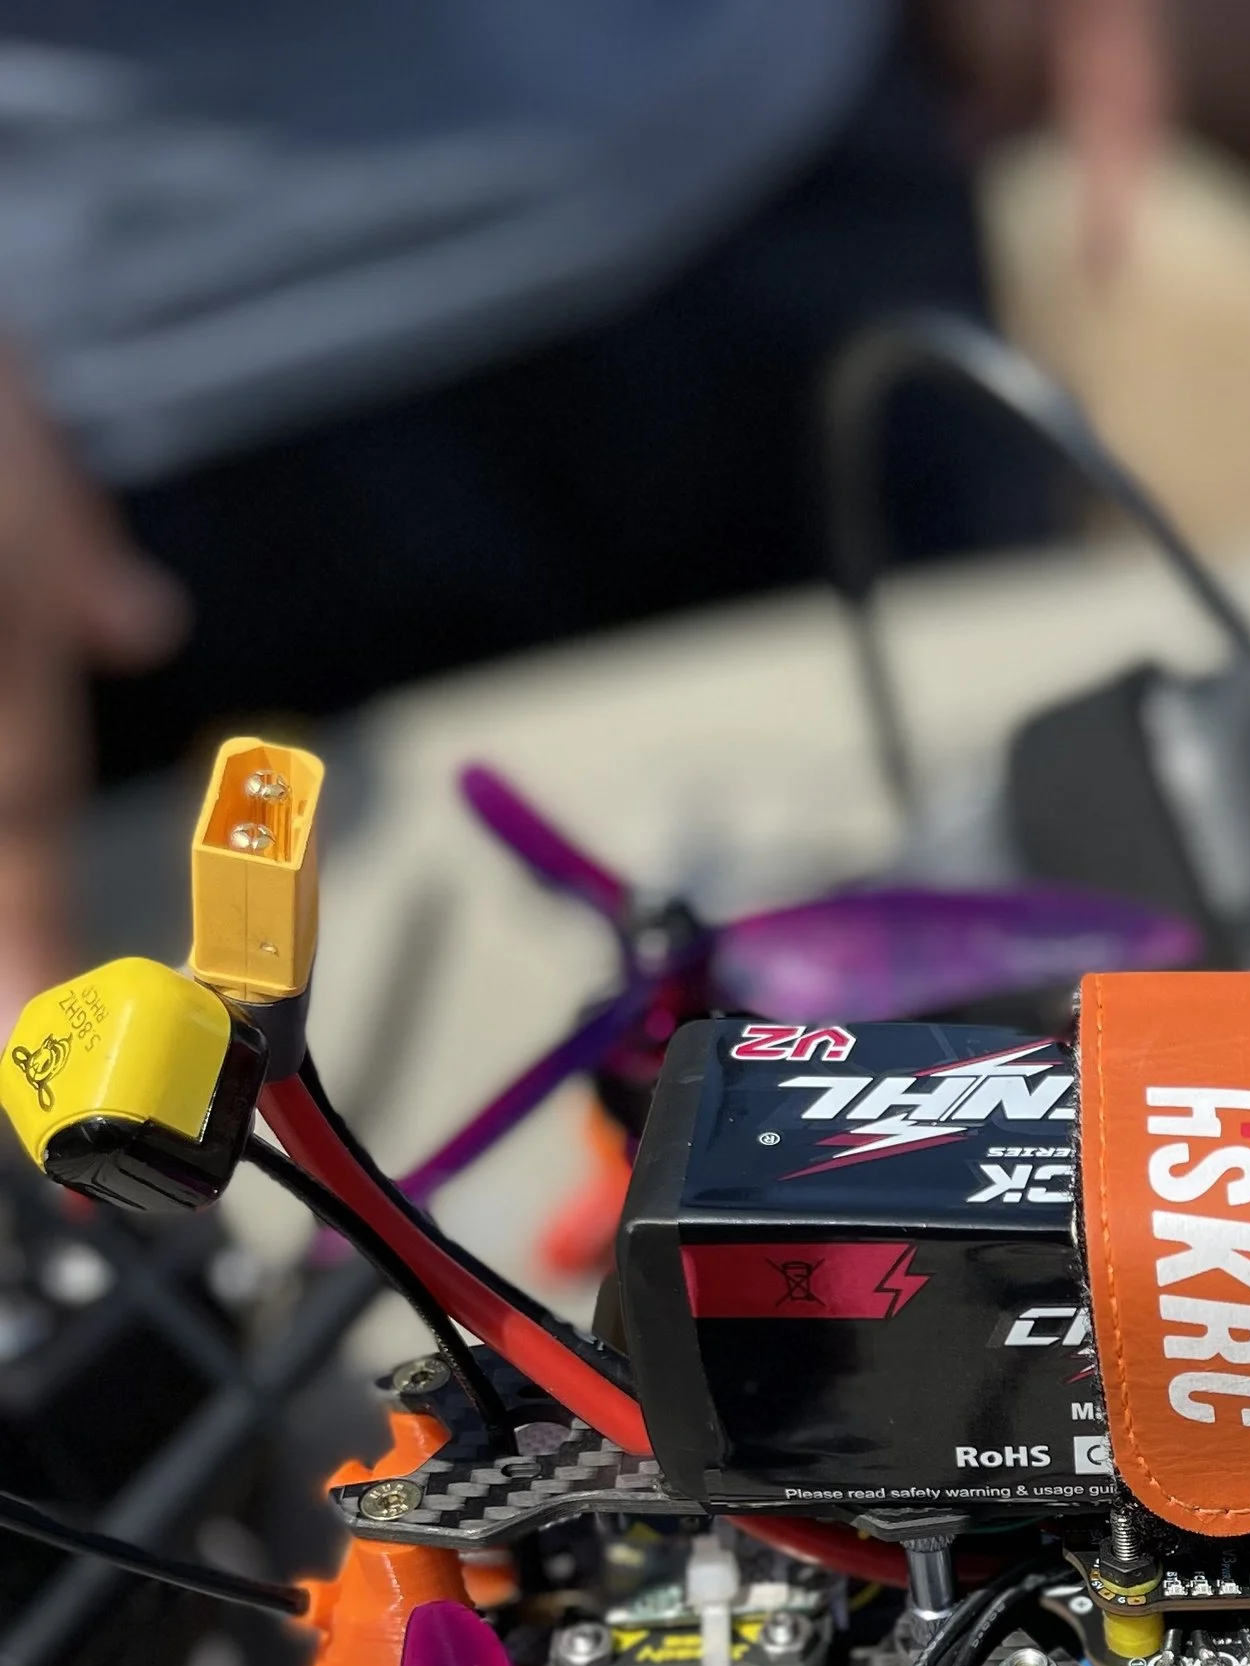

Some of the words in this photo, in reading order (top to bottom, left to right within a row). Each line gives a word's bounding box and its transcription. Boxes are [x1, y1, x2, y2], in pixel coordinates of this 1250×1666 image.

[986, 1147, 1072, 1158] ERIES
[955, 1445, 1051, 1468] RoHS
[785, 1487, 843, 1500] Please
[848, 1487, 885, 1499] read
[891, 1486, 940, 1500] safety
[945, 1486, 1011, 1499] warning
[1016, 1485, 1029, 1496] &
[1033, 1485, 1085, 1498] usage
[1088, 1483, 1117, 1497] gui
